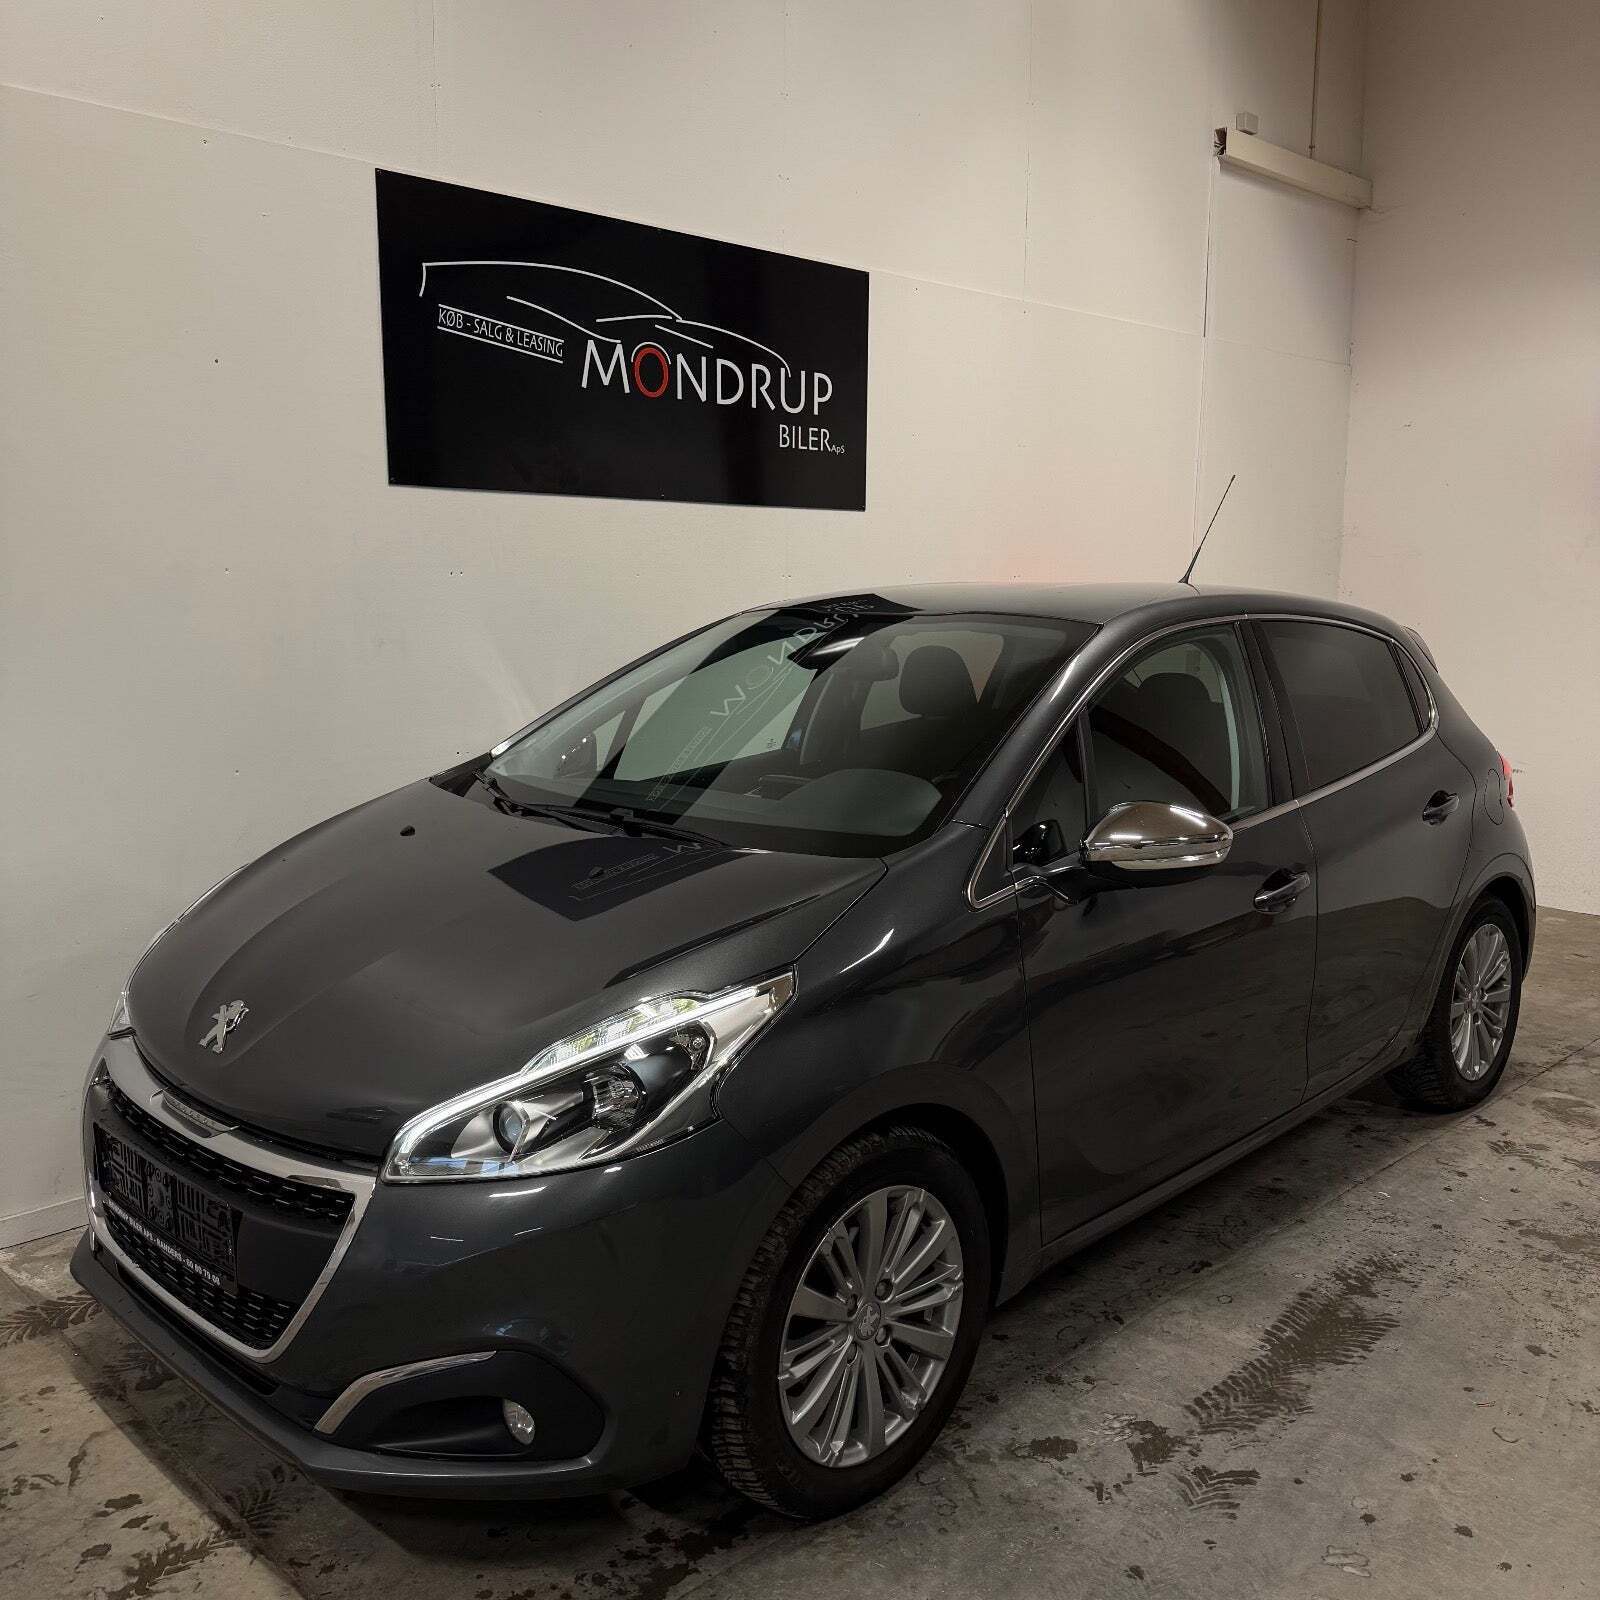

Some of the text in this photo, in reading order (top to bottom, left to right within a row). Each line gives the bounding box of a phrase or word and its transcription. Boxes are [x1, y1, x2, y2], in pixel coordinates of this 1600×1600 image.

[438, 307, 464, 329] KØB
[473, 318, 503, 341] SALG
[505, 327, 515, 344] &
[517, 330, 563, 358] LEASING
[581, 339, 833, 415] MONDRUP
[779, 423, 846, 456] BILER ApS
